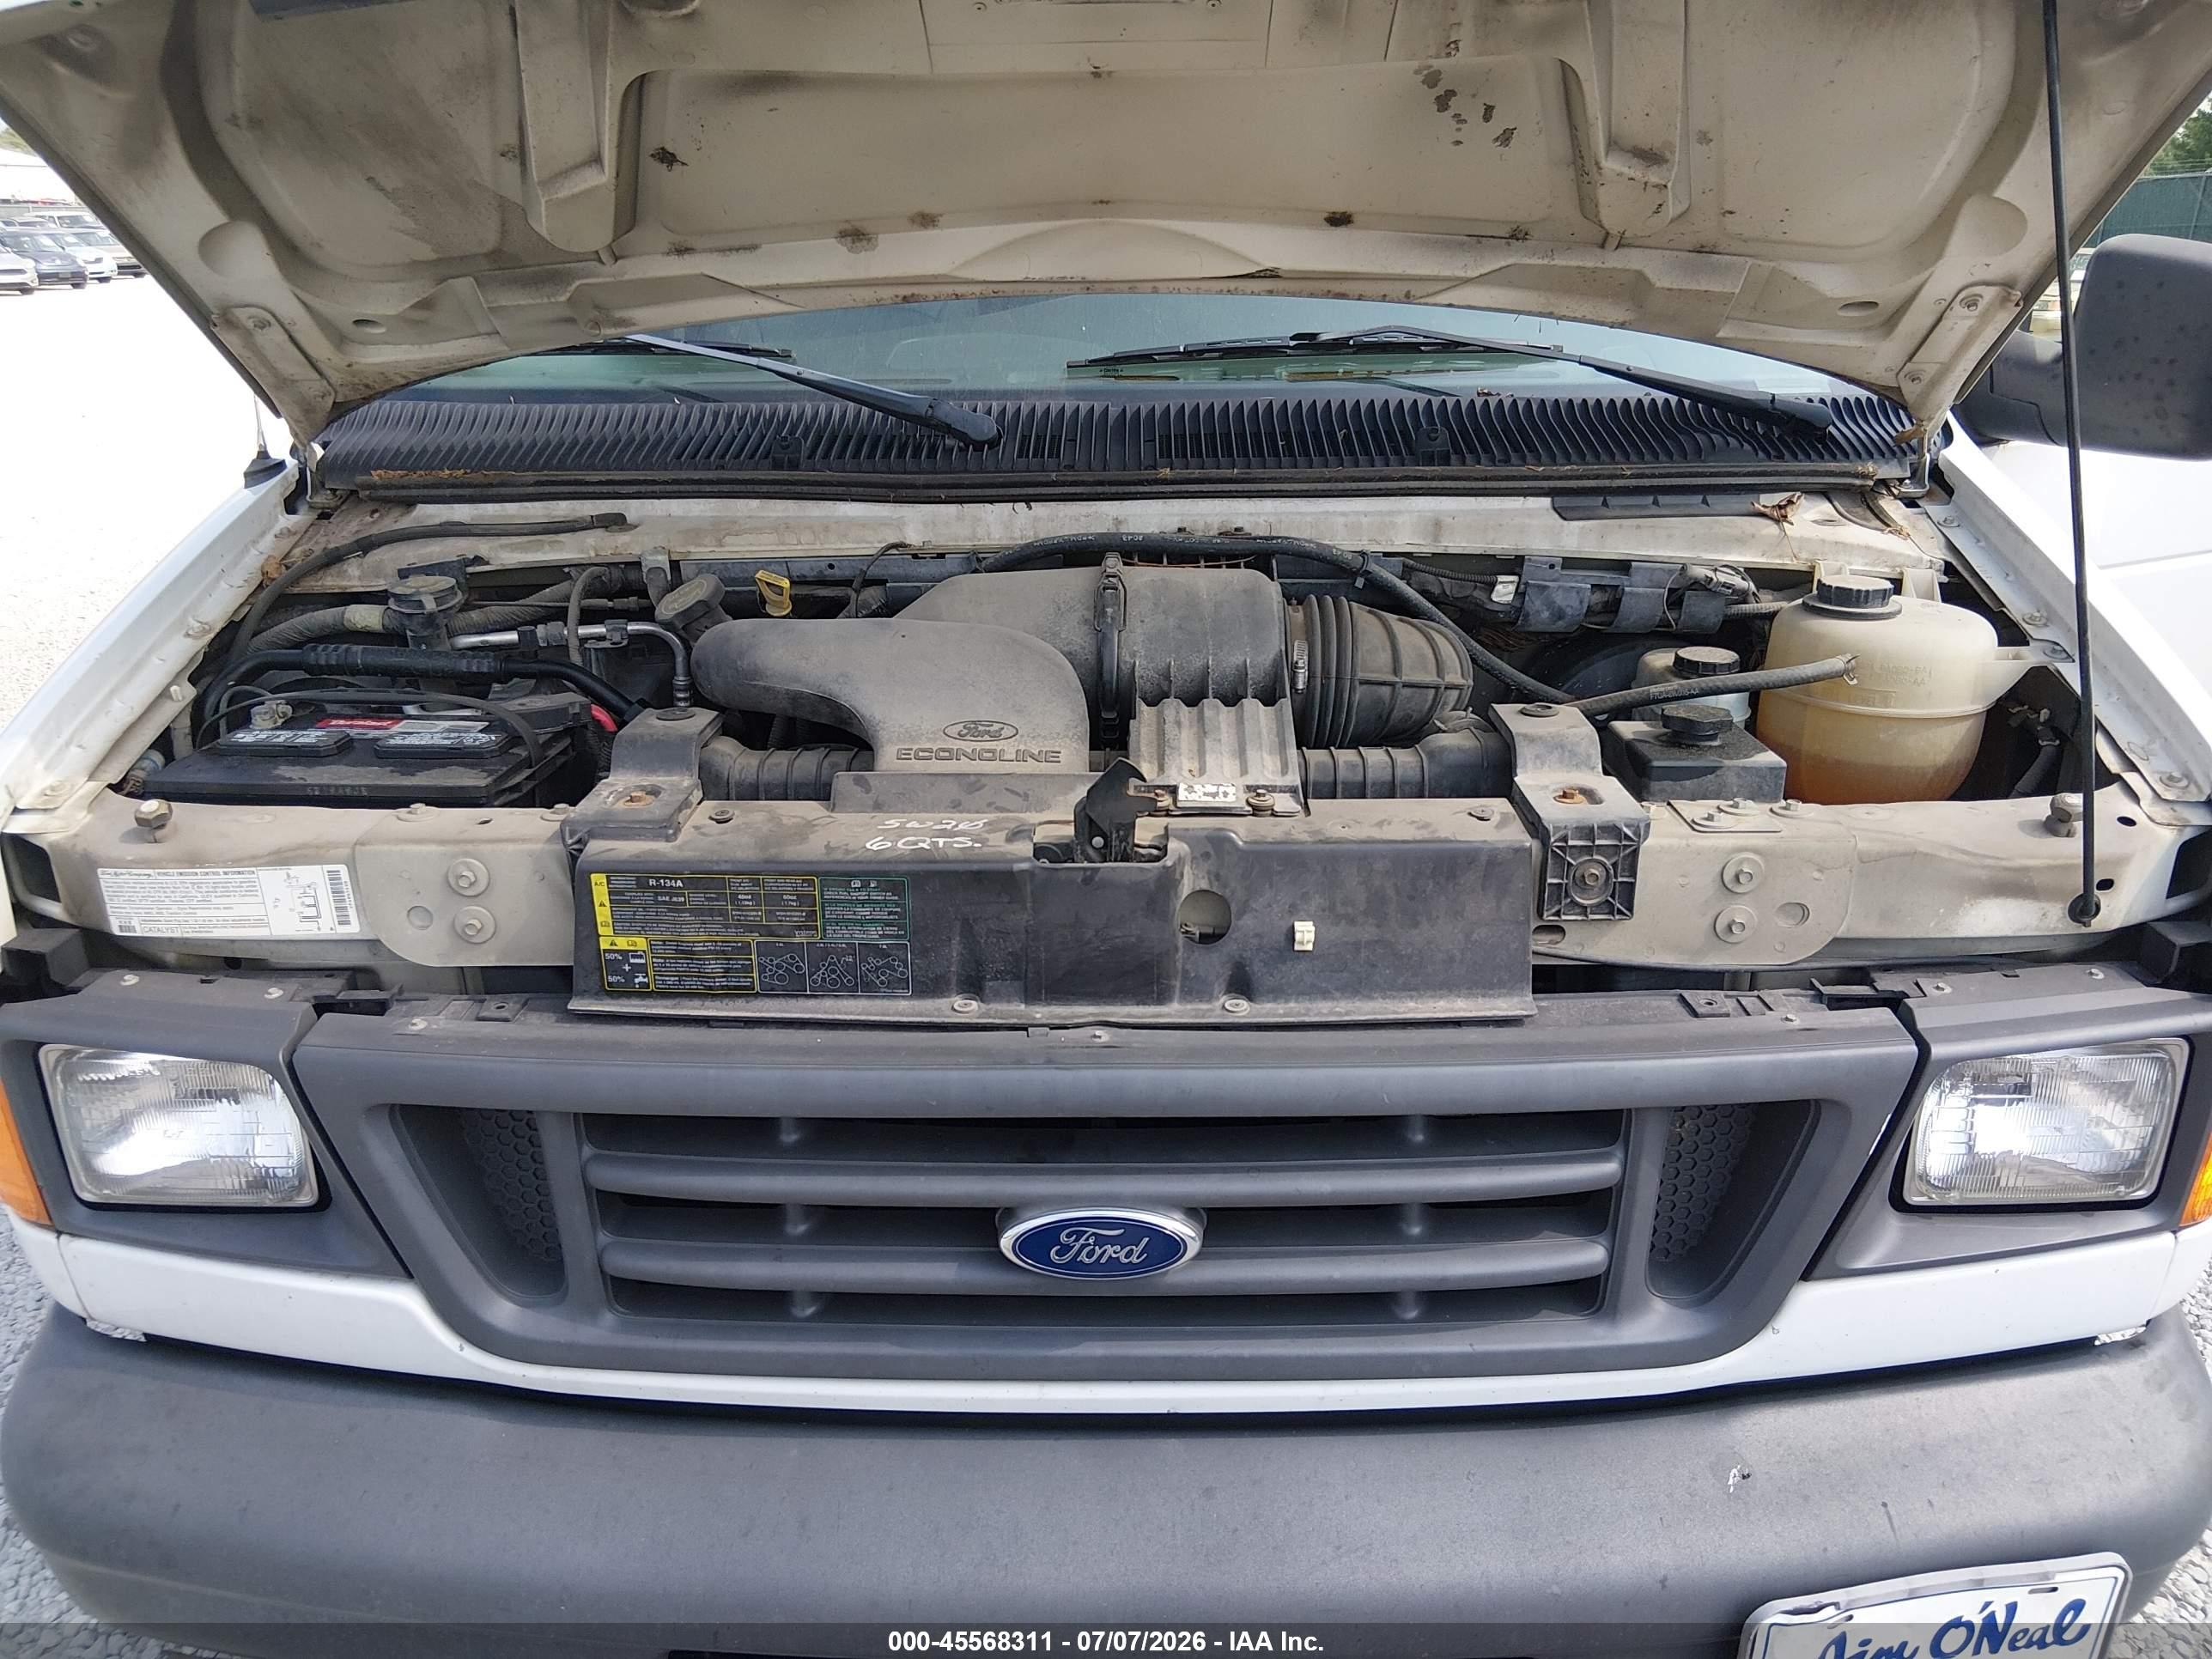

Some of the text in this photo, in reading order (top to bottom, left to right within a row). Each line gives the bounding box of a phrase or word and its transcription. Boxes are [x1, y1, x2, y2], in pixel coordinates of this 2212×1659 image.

[957, 720, 1005, 738] Ford
[896, 746, 1062, 763] ECONOLINE
[648, 878, 684, 888] R-134A
[143, 926, 179, 934] CATALYST
[605, 952, 623, 961] 50%
[607, 975, 626, 983] 50%
[1049, 1226, 1151, 1265] Ford
